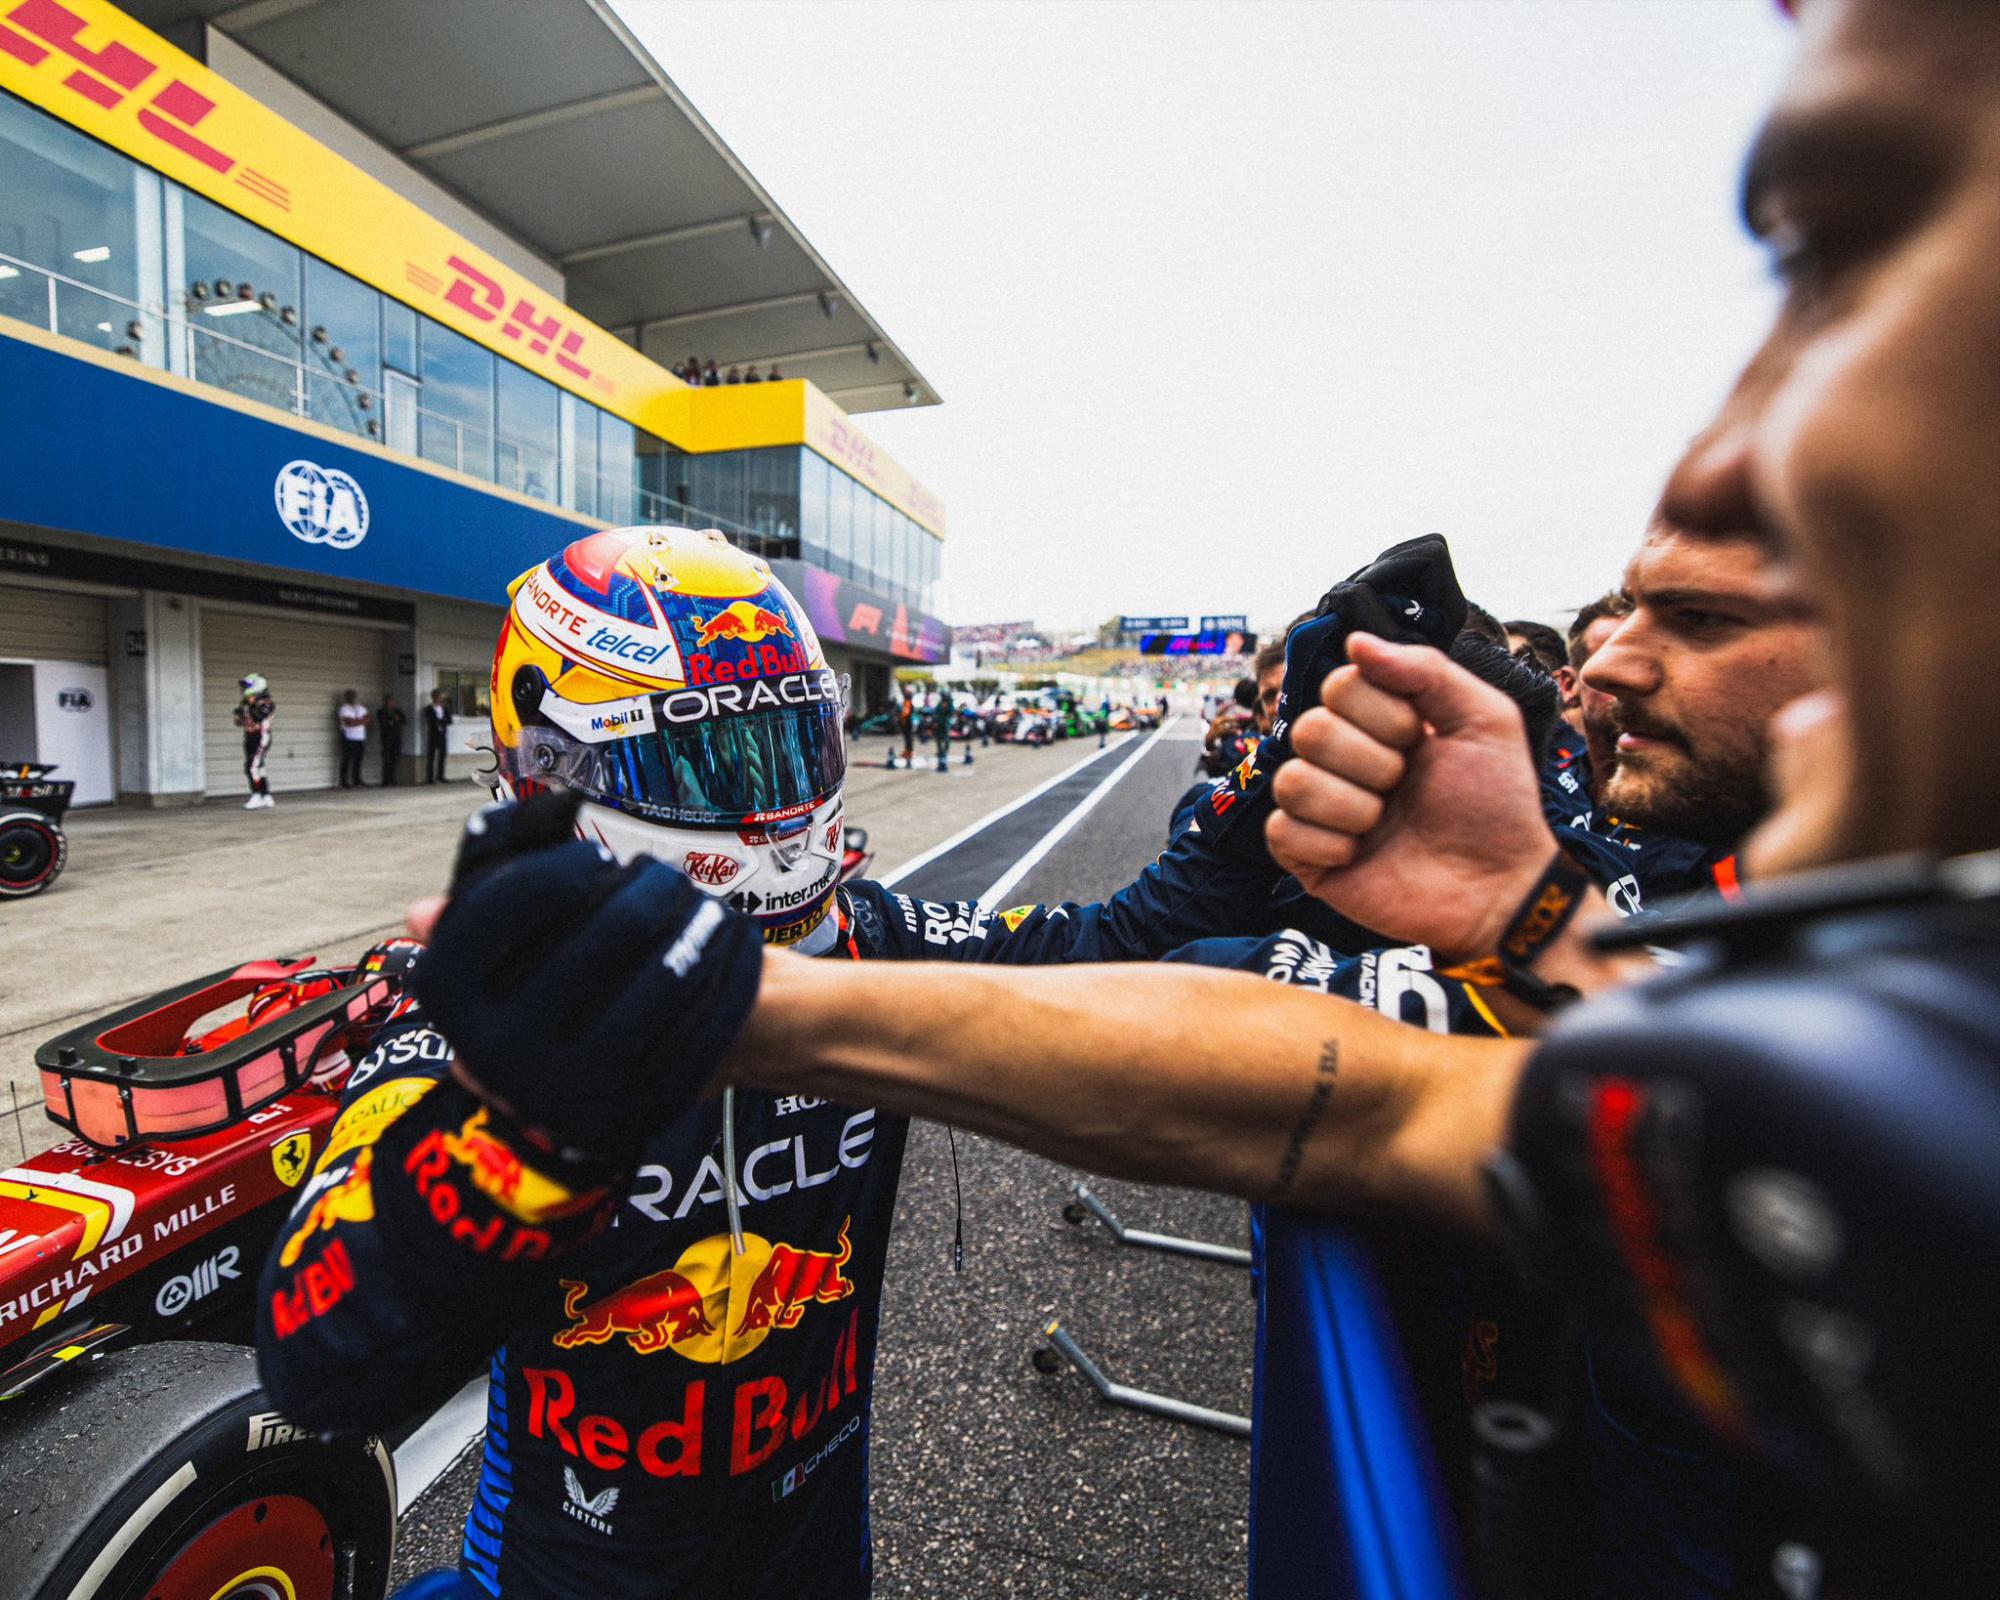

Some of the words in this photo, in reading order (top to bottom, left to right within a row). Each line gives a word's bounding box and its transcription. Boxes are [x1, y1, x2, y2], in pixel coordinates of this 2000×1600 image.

[0, 0, 236, 174] HL
[444, 255, 591, 370] DHL
[278, 472, 362, 538] FIA
[586, 627, 671, 664] telcel
[689, 646, 759, 686] Red
[760, 641, 808, 675] Bull
[591, 711, 628, 730] Mobil
[662, 674, 835, 723] ORACLE
[766, 801, 816, 820] BANORTE
[686, 854, 737, 884] KitKat
[1359, 952, 1376, 1010] RACIN
[612, 1107, 876, 1227] RACLE
[0, 1233, 143, 1328] RICHARD
[154, 1184, 236, 1241] MILLE
[522, 1366, 706, 1478] Red
[730, 1305, 858, 1477] Bull
[804, 1415, 860, 1474] CHECO
[562, 1500, 613, 1535] CASTORE
